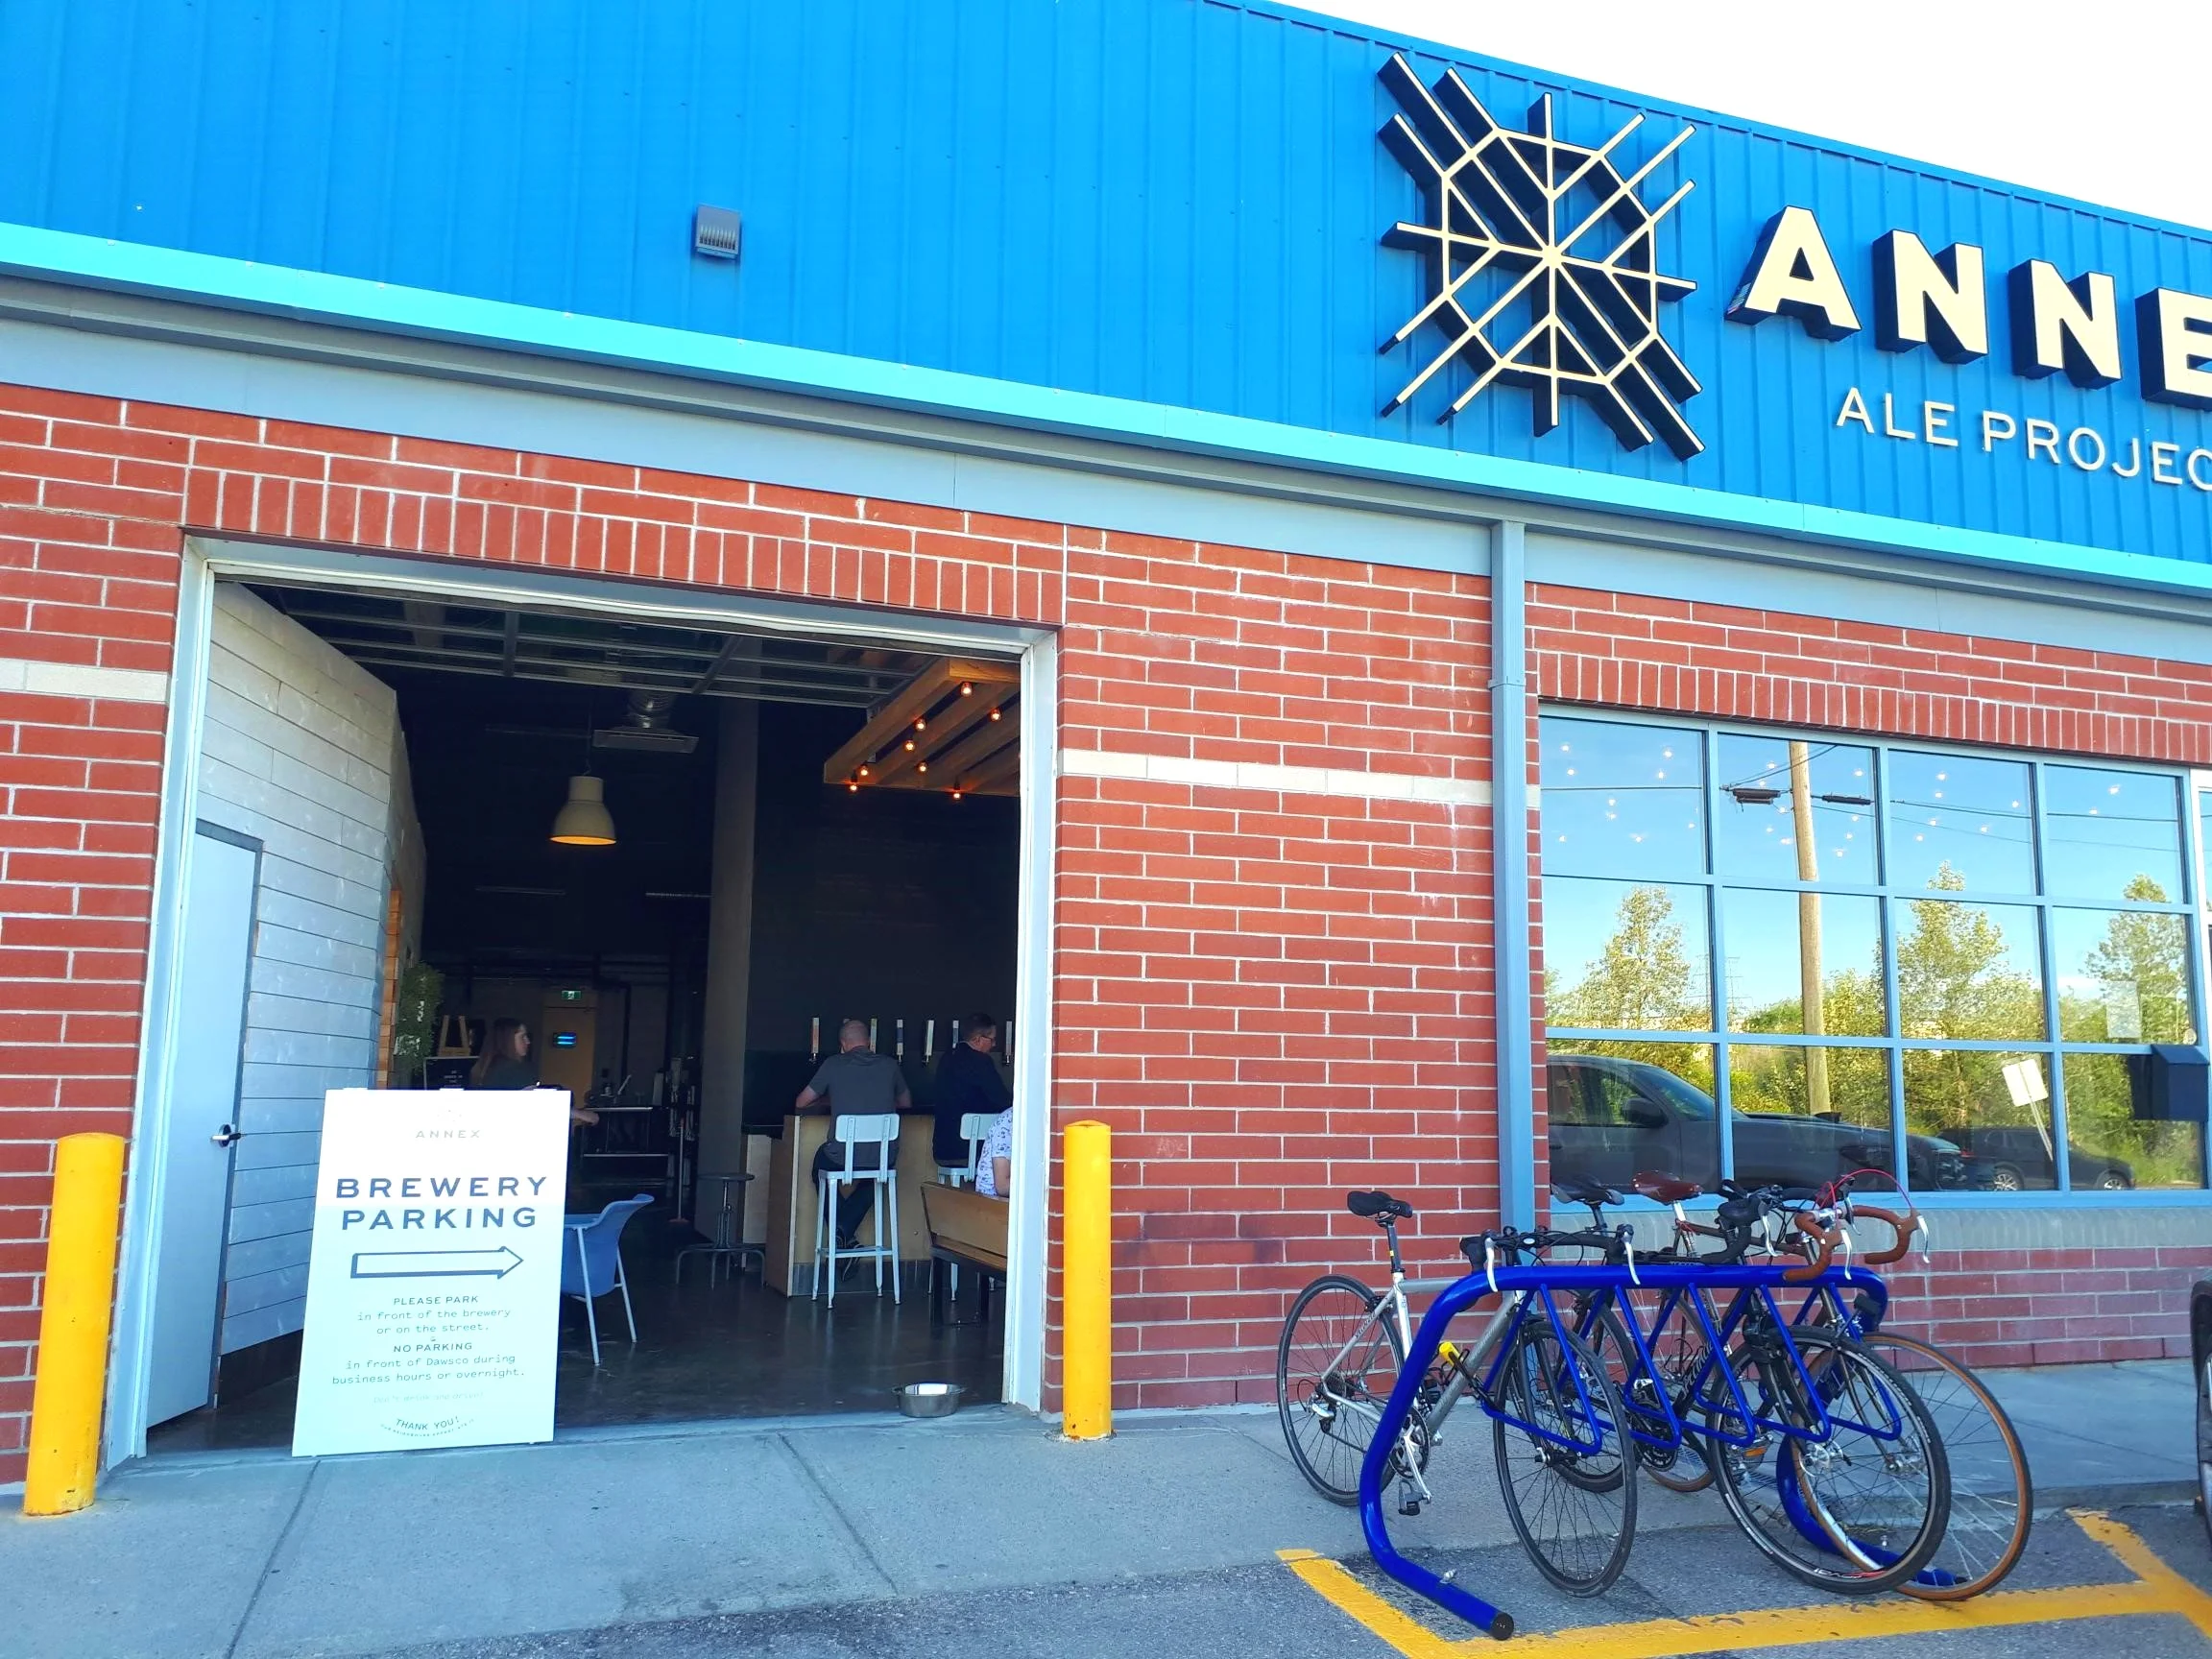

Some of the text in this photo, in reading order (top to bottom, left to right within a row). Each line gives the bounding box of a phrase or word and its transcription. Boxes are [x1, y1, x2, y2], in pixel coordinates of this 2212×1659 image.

[1836, 387, 1959, 447] ALE
[416, 1130, 480, 1139] ANNEX
[336, 1176, 547, 1199] BREWERY
[342, 1207, 536, 1230] PARKING
[394, 1297, 442, 1306] PLEASE
[358, 1312, 372, 1321] in
[377, 1311, 412, 1320] front
[418, 1310, 432, 1319] of
[463, 1309, 511, 1317] brewery
[442, 1323, 489, 1332] street.
[416, 1343, 472, 1352] PARKING
[407, 1358, 421, 1367] of
[426, 1358, 469, 1366] Dawsco
[473, 1356, 516, 1364] during
[332, 1375, 390, 1384] business
[397, 1373, 431, 1382] hours
[456, 1368, 524, 1379] overnight.
[396, 1418, 428, 1431] THANK
[434, 1416, 459, 1429] YOU!
